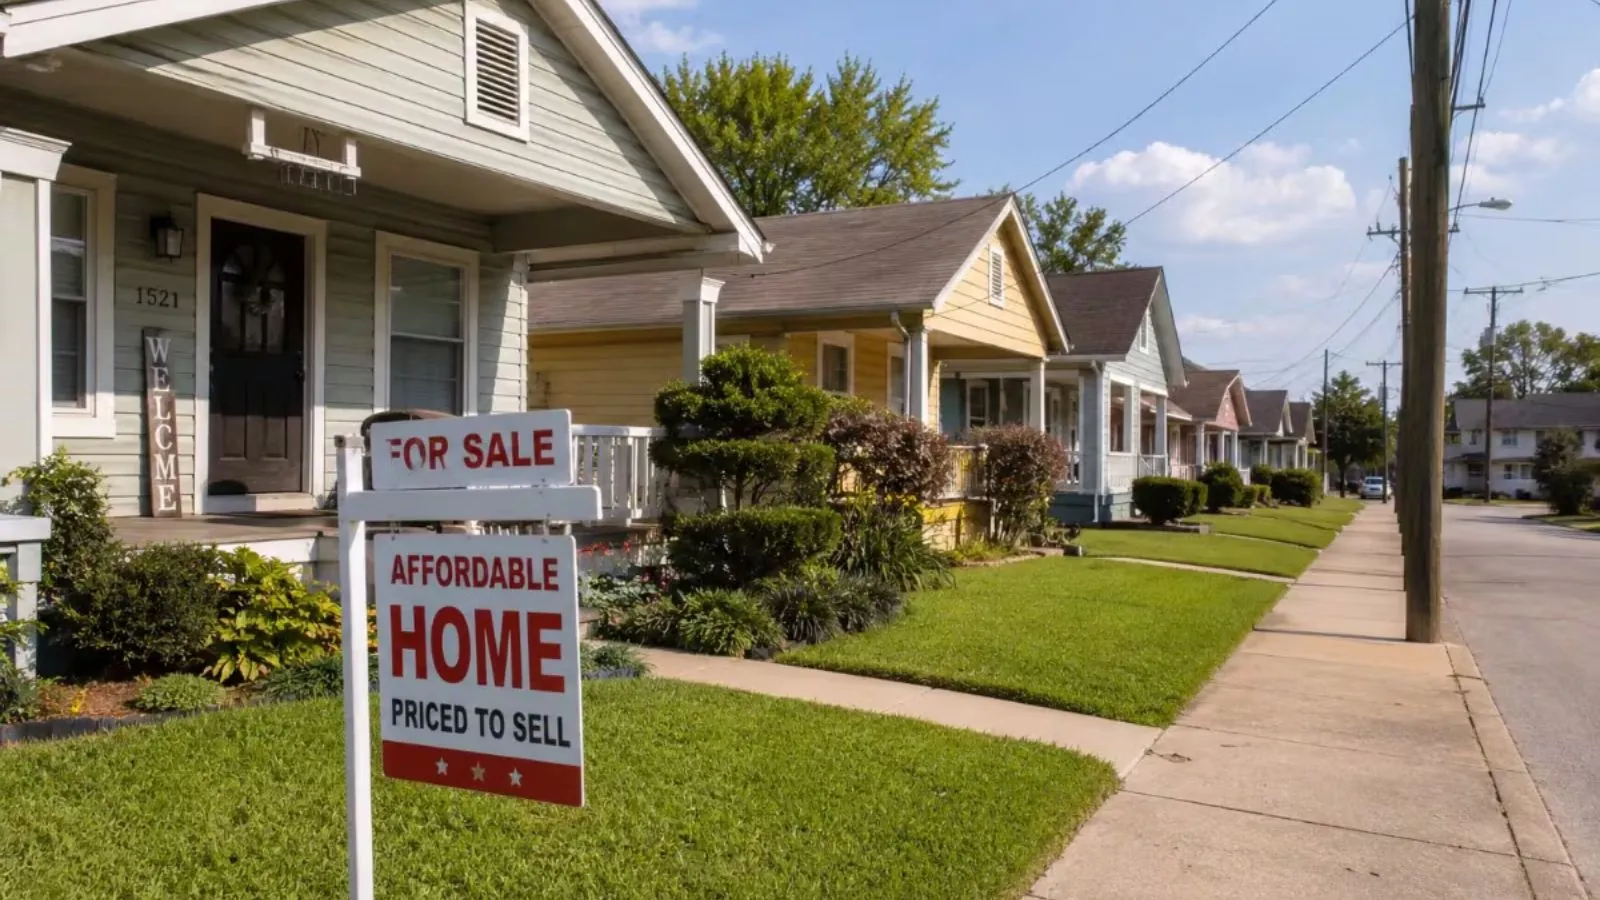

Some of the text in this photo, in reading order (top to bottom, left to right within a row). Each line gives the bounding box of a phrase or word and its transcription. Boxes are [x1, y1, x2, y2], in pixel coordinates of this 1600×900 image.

[136, 287, 180, 308] 1521
[463, 429, 555, 469] SALE
[390, 554, 560, 591] AFFORDABLE
[389, 604, 566, 693] HOME
[391, 698, 571, 748] PRICED TO SELL
